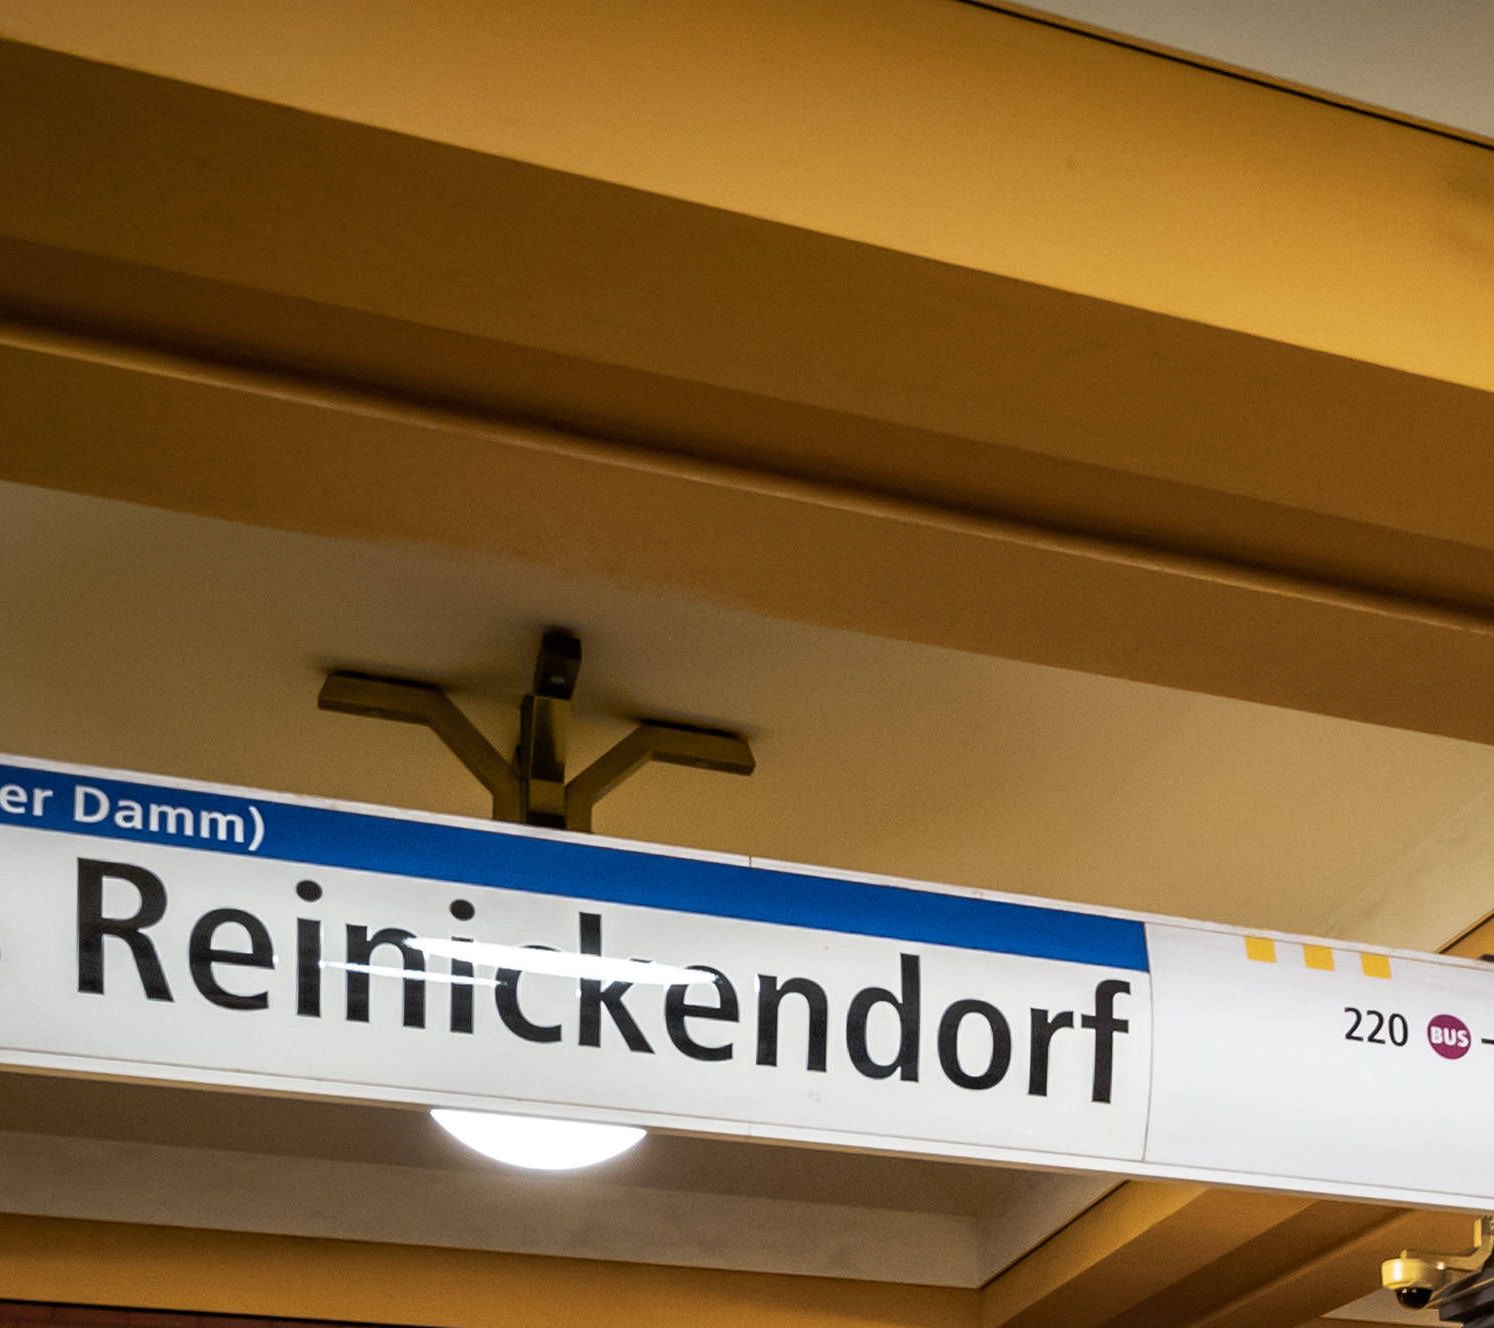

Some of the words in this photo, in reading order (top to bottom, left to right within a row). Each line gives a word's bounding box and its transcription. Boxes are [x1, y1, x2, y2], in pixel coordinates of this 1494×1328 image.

[72, 784, 266, 852] Damm)
[74, 856, 1133, 1104] Reinickendorf
[1344, 1006, 1409, 1047] 220
[1429, 1025, 1470, 1048] BUS
